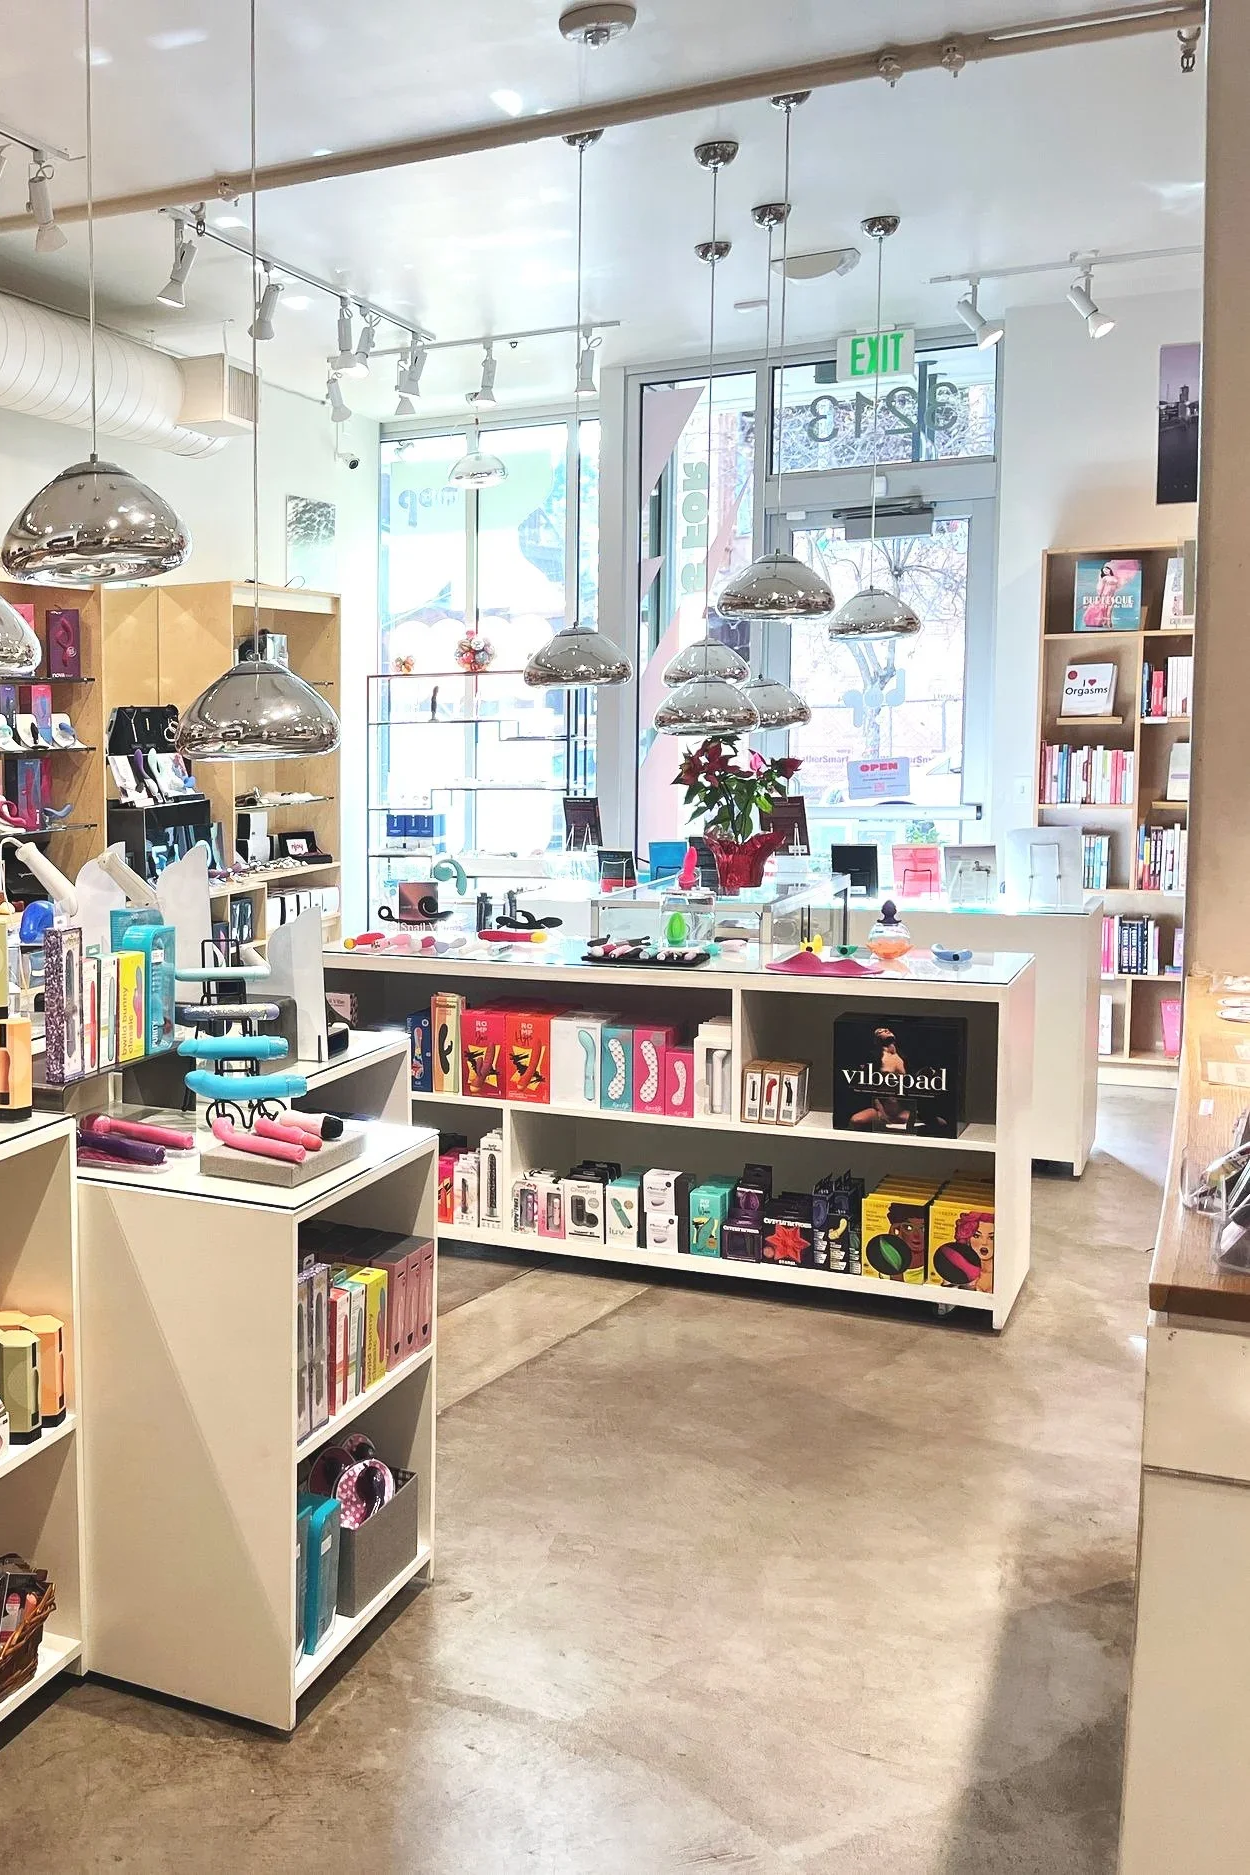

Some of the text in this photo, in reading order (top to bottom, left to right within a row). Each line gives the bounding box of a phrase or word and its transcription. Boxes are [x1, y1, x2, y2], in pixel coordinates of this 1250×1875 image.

[851, 333, 904, 376] EXIT
[1082, 594, 1134, 605] BURLESQUE
[1065, 686, 1108, 697] Orgasms
[859, 762, 899, 772] OPEN
[842, 1062, 950, 1096] vibepad
[570, 1187, 597, 1195] Charged
